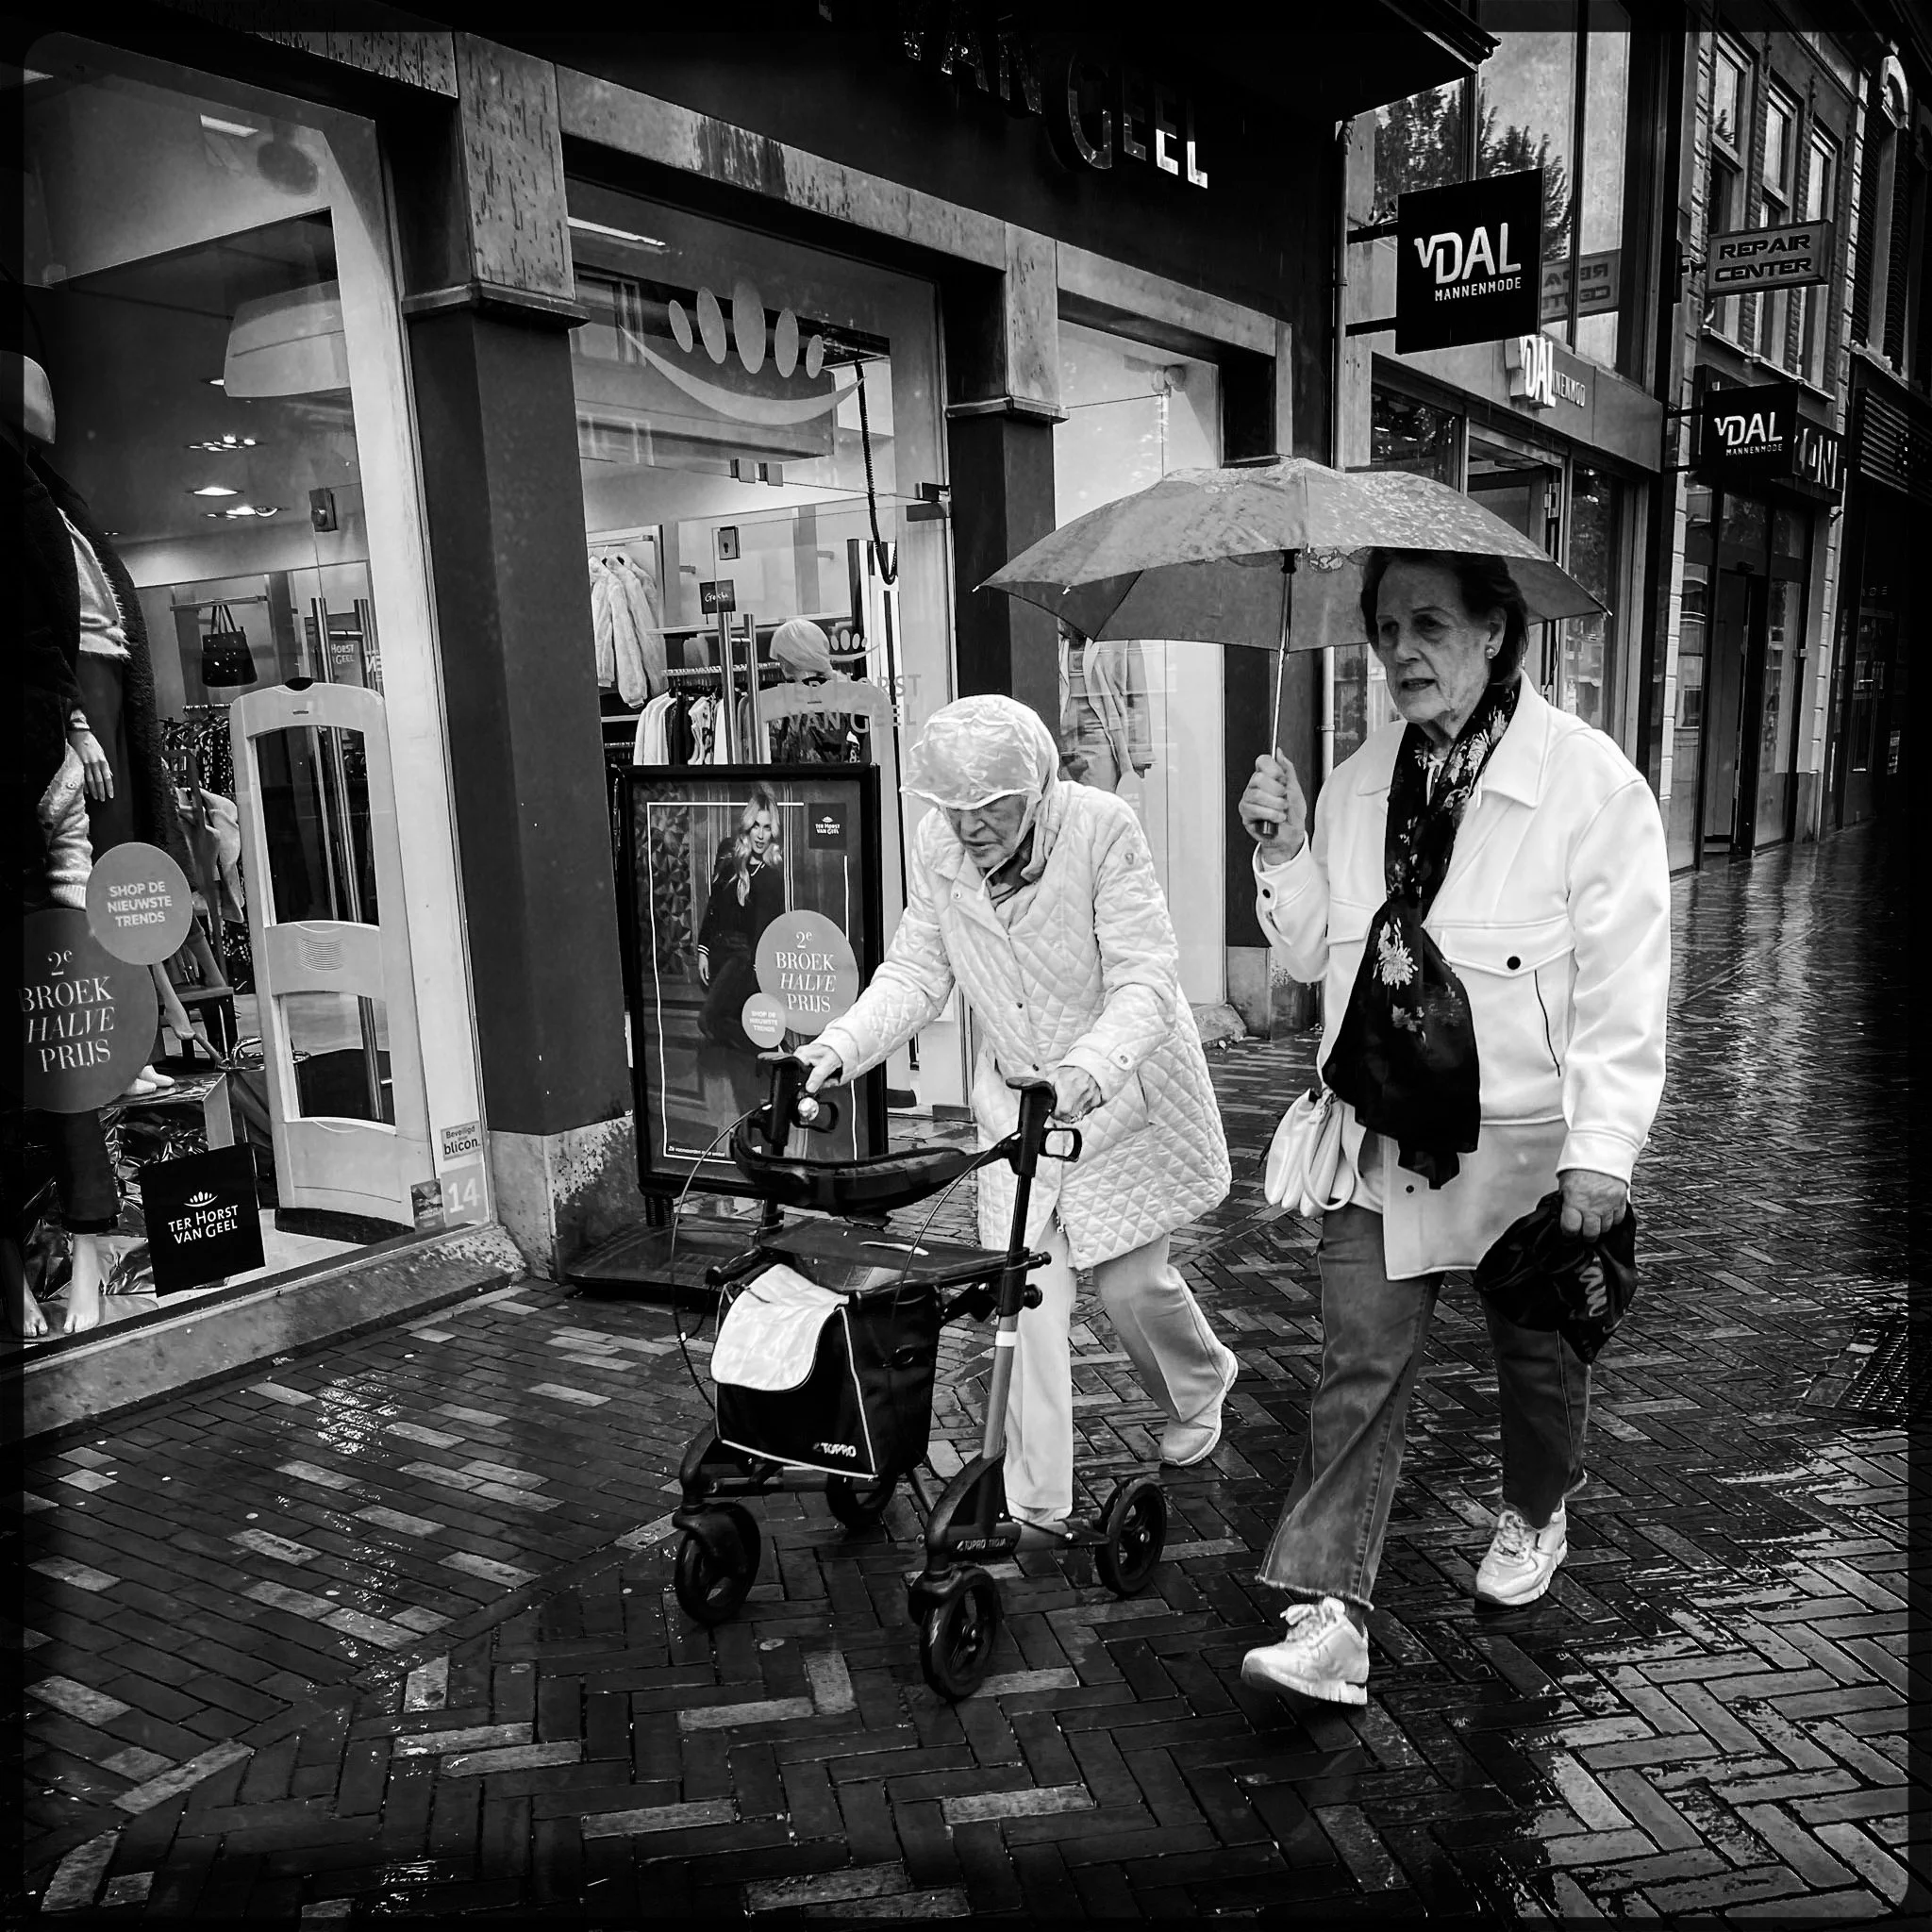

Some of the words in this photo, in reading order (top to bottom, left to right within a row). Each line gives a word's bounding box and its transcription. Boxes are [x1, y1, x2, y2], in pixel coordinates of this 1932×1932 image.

[1067, 51, 1208, 189] GEEL
[1719, 234, 1811, 260] REPAIR
[1714, 257, 1812, 282] CENTER
[1435, 277, 1522, 301] MANNENMODE
[1725, 443, 1783, 456] MANNENMODE
[108, 883, 145, 897] SHOP
[148, 881, 166, 893] DE
[107, 895, 173, 913] NIEUWSTE
[115, 910, 166, 927] TRENDS
[775, 951, 836, 971] BROEK
[20, 975, 114, 1012] BROEK
[779, 972, 837, 992] HALVE
[787, 992, 831, 1013] PRIJS
[27, 1006, 115, 1043] HALVE
[39, 1039, 111, 1073] PRIJS
[448, 1177, 481, 1214] 14
[168, 1218, 192, 1232] TER
[195, 1205, 238, 1225] HORST
[174, 1227, 202, 1244] VAN
[205, 1219, 238, 1238] GEEL
[821, 1441, 857, 1457] TOPRO
